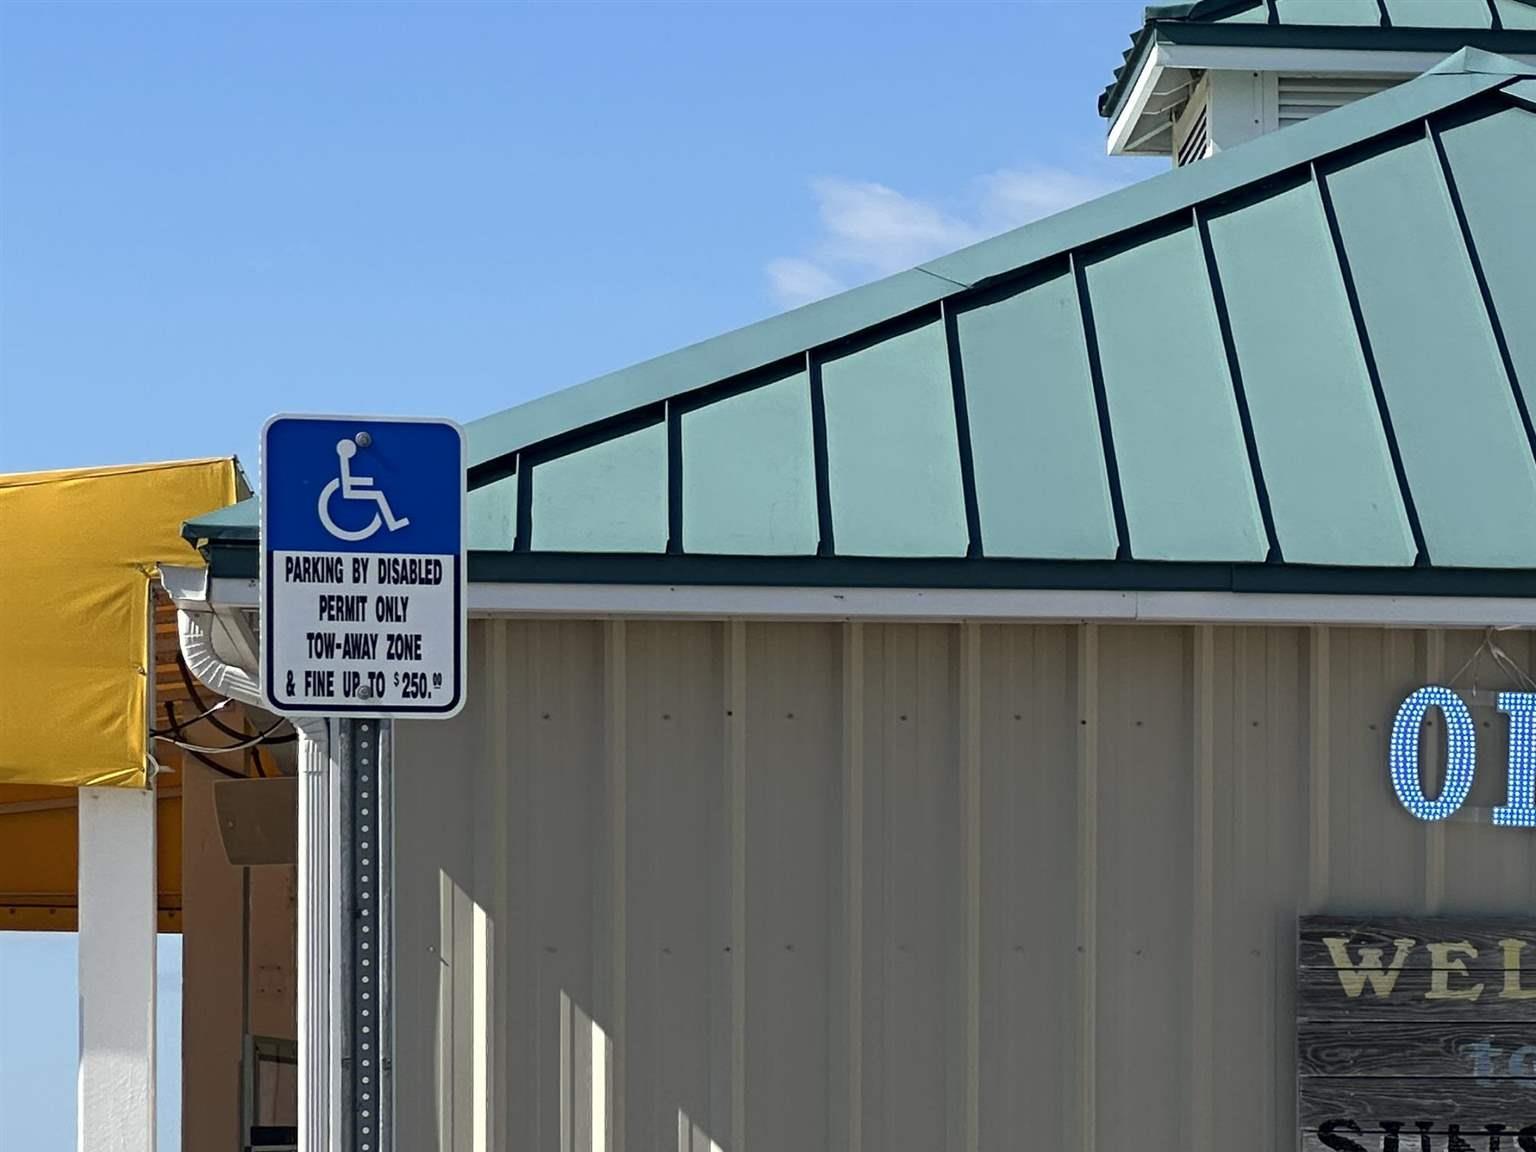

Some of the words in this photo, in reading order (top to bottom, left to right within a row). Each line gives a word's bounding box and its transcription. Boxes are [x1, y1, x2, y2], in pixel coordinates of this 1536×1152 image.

[285, 556, 343, 584] PARKING
[352, 557, 369, 585] BY
[377, 558, 443, 586] DISABLED
[318, 595, 368, 622] PERMIT
[375, 596, 409, 623] ONLY
[306, 632, 379, 660] TOW-AWAY
[386, 634, 422, 661] ZONE
[285, 670, 296, 697] &
[304, 671, 334, 697] FINE
[342, 671, 361, 698] UP
[367, 672, 385, 698] TO
